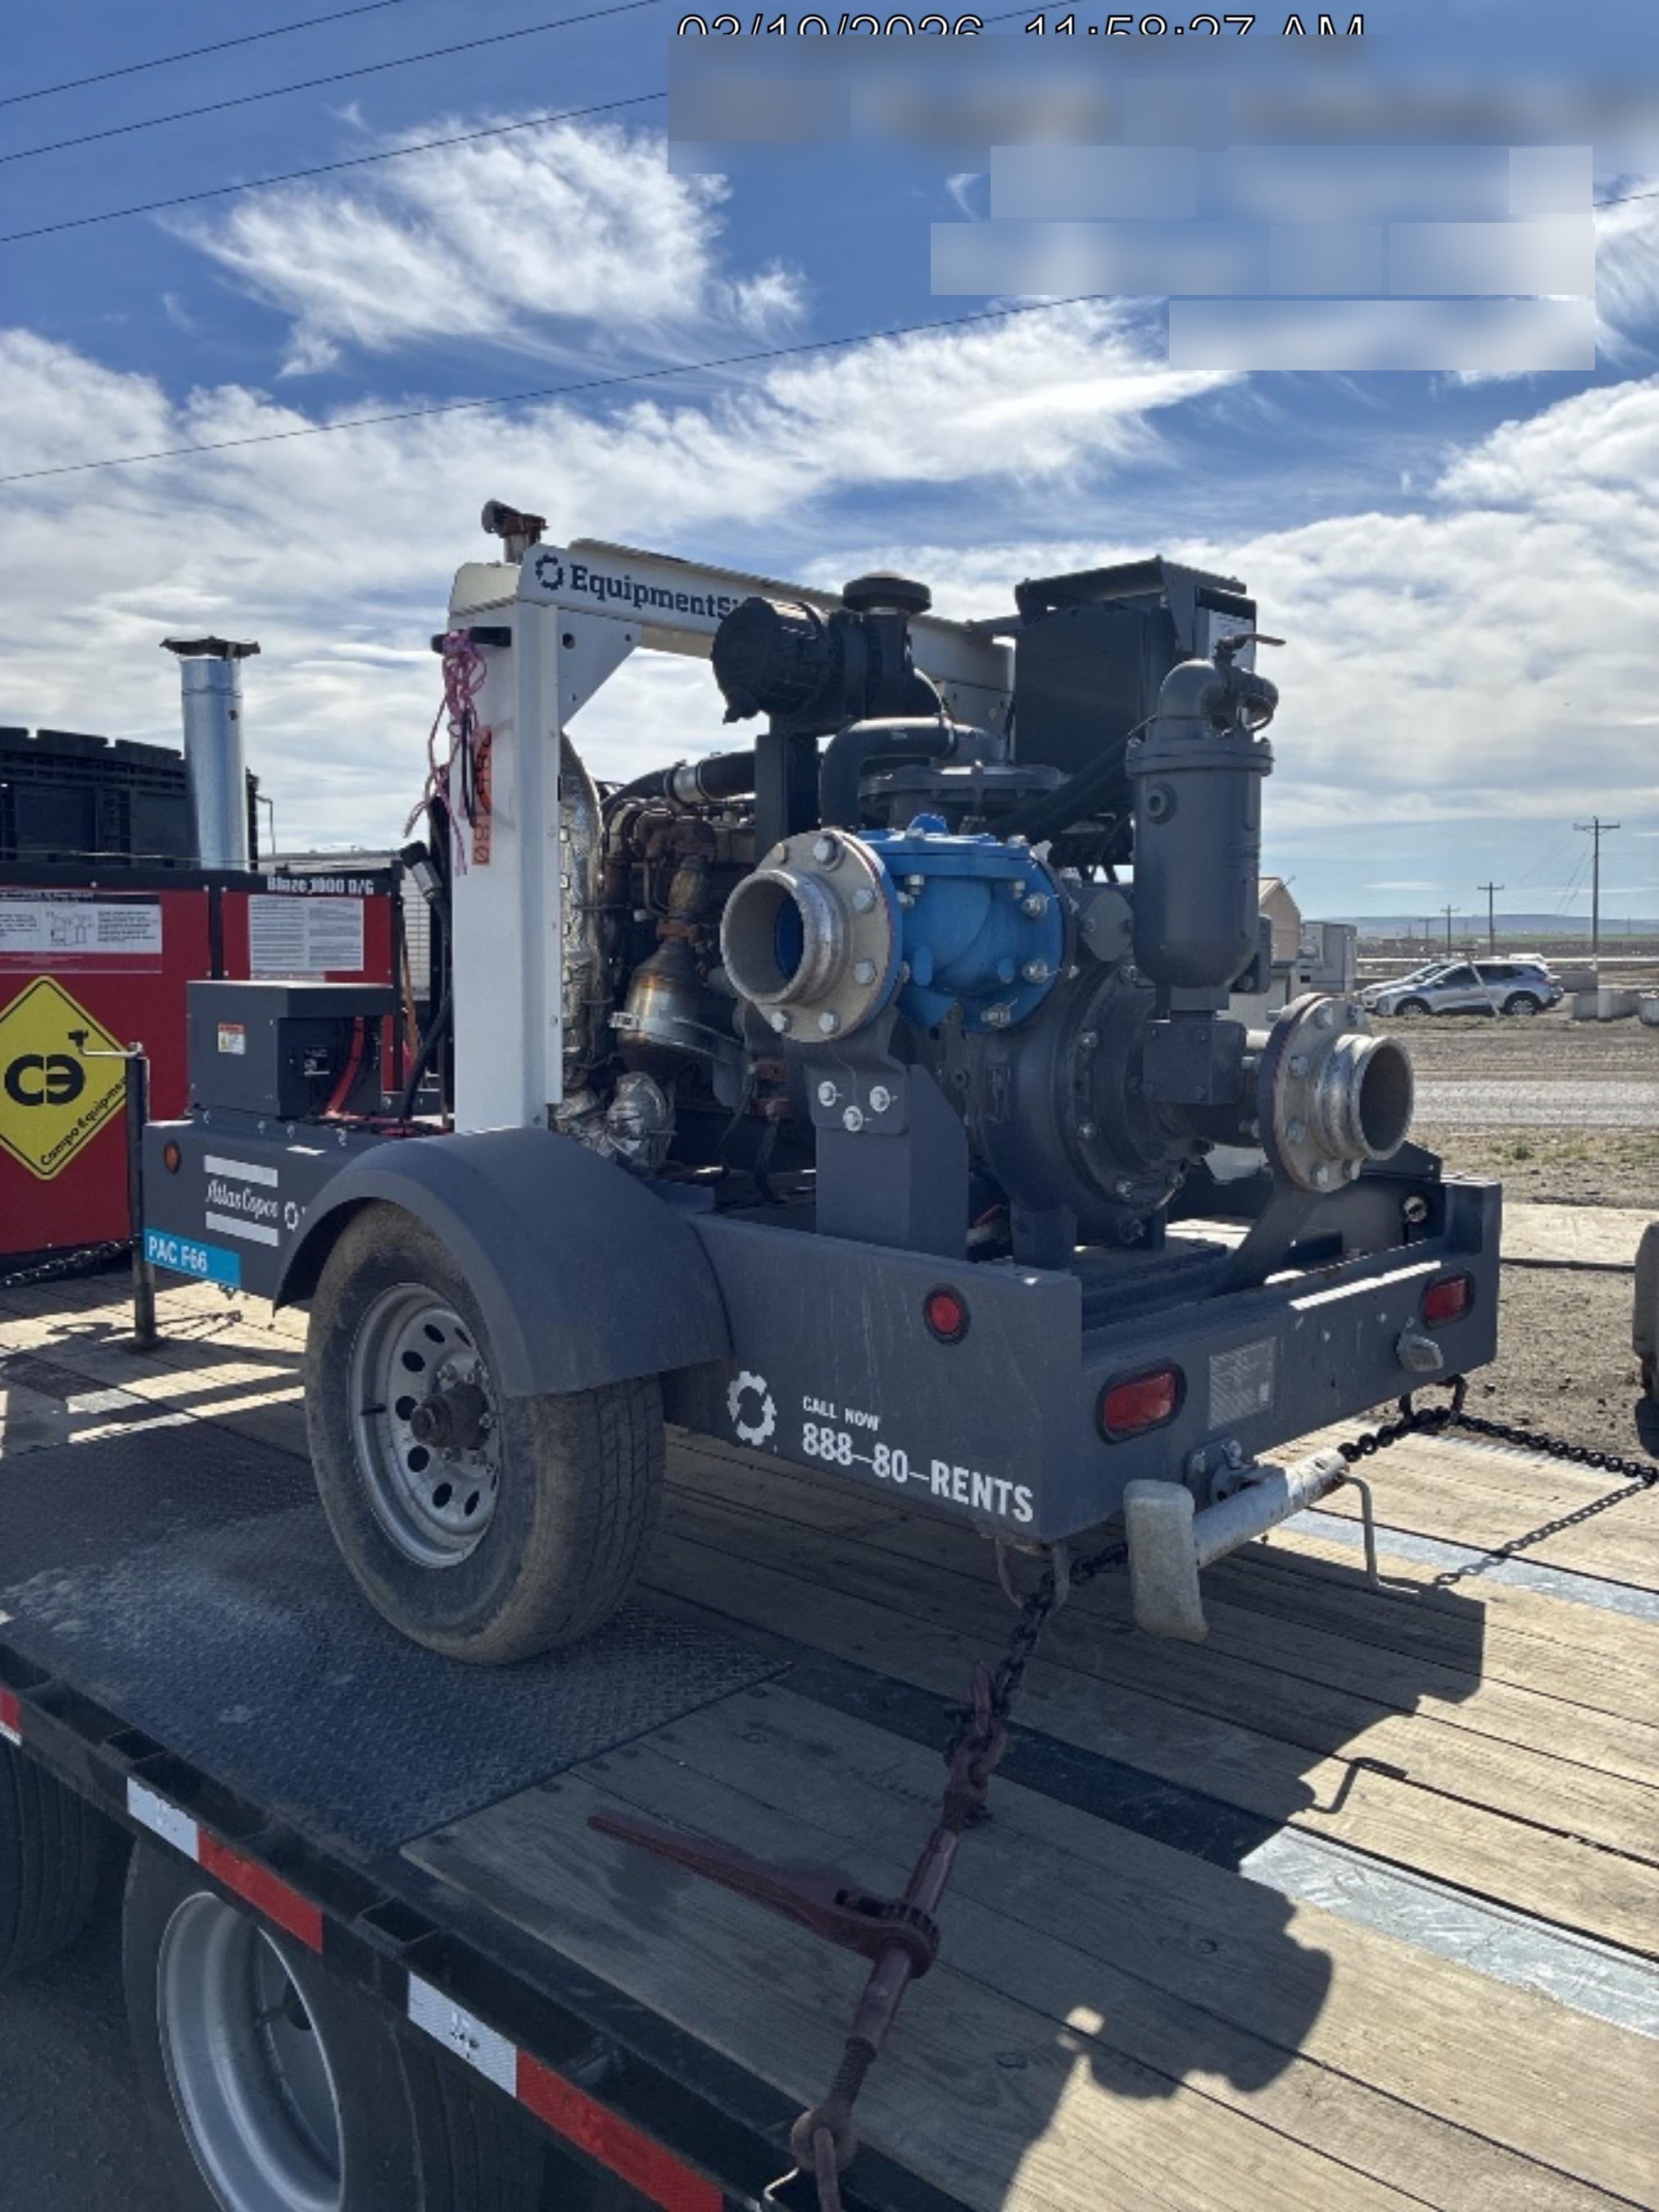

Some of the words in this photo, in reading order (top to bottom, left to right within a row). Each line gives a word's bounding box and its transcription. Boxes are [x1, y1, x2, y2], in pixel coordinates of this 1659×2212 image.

[569, 563, 738, 619] EquipmentS
[206, 1179, 241, 1209] Atlas
[243, 1187, 279, 1220] Copco
[148, 1235, 178, 1264] PAC
[181, 1244, 208, 1272] F66
[803, 1395, 837, 1419] CALL
[845, 1407, 882, 1431] NOW
[801, 1422, 1035, 1523] 888-80-RENTS
